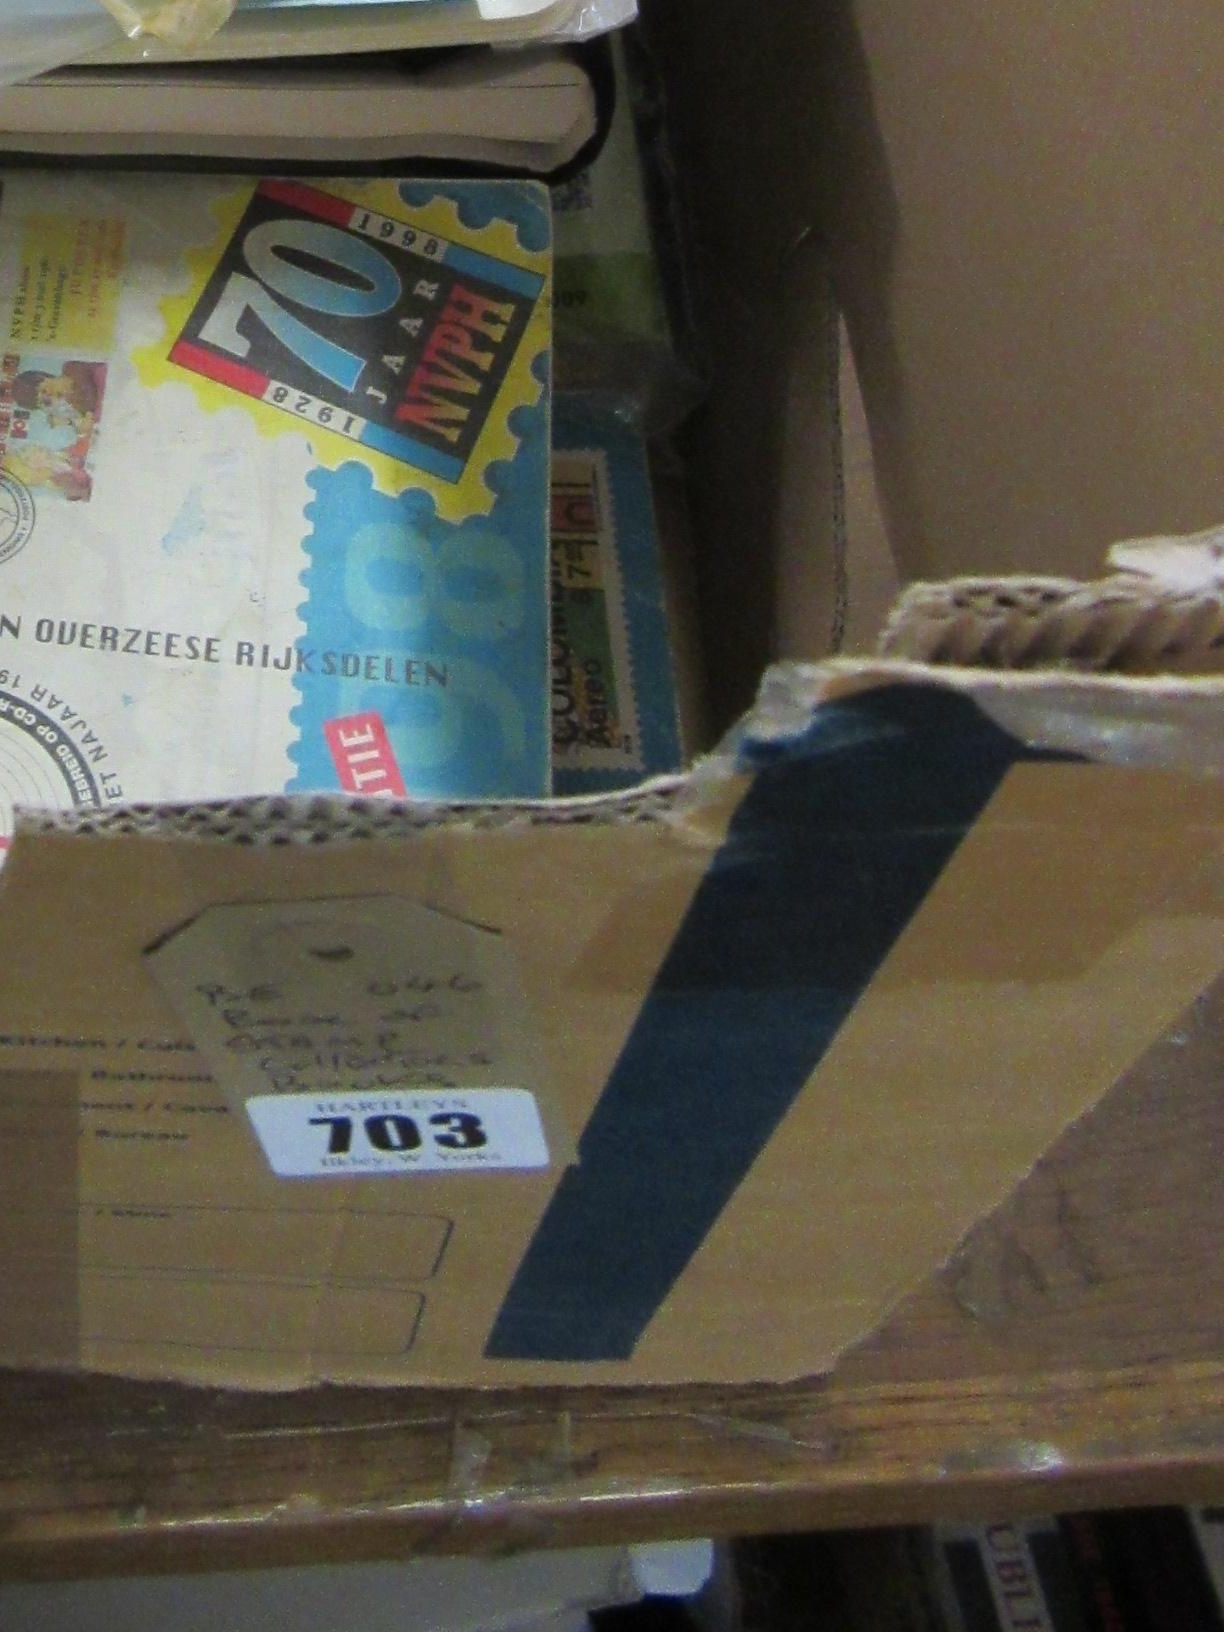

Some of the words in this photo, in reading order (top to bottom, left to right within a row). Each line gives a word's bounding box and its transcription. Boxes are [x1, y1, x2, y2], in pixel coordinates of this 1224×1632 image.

[355, 213, 441, 258] 1998
[197, 218, 403, 394] 70
[365, 276, 441, 405] JAAR
[395, 281, 519, 443] NVPH
[271, 387, 355, 435] 1928
[35, 617, 220, 663] OVERZEESE
[236, 640, 449, 688] RIJKSDELEN
[29, 683, 108, 763] NAJAAR
[36, 724, 58, 744] OP
[100, 771, 123, 806] ET
[316, 1098, 468, 1113] HARTLEYS
[308, 1111, 488, 1153] 703
